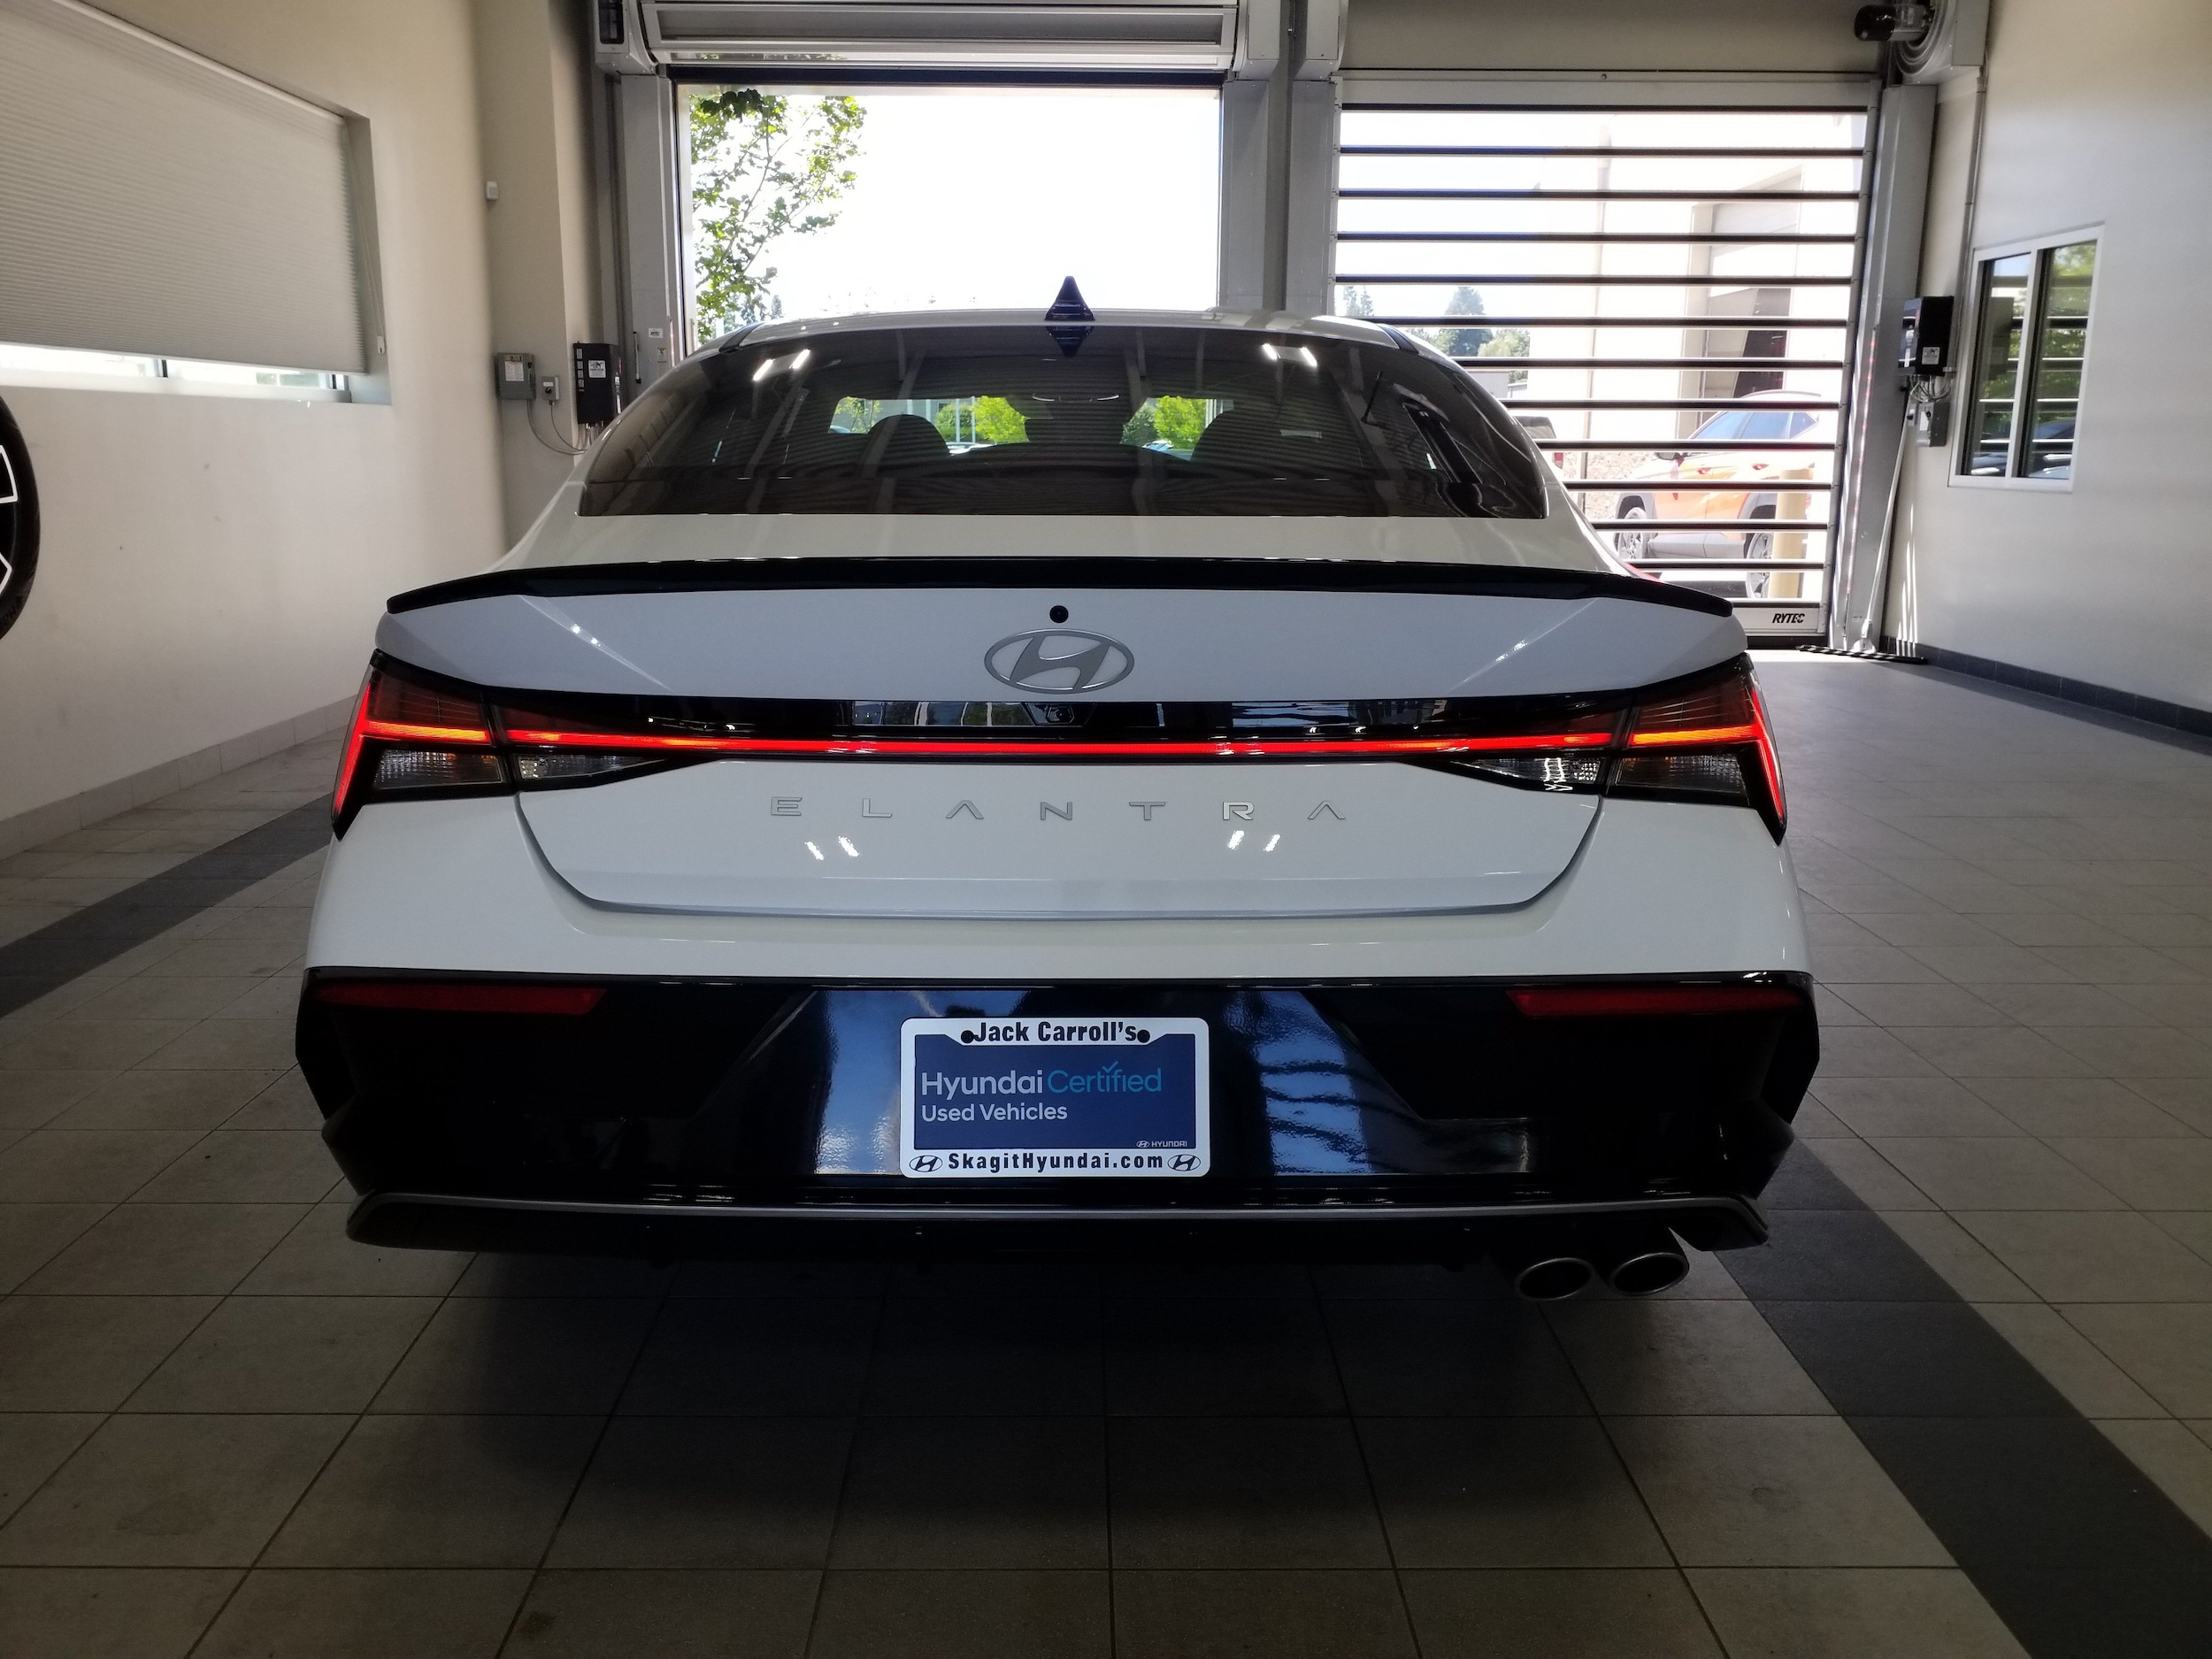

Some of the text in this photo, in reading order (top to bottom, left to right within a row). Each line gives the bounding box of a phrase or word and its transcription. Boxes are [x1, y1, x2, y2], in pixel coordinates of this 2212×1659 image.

[1772, 613, 1805, 623] RYTEC
[771, 796, 1346, 820] ELANTRA
[974, 1021, 1137, 1042] Jack Carroll's
[921, 1061, 1162, 1100] Hyundai Certified
[921, 1102, 1068, 1122] Used Vehicles
[948, 1153, 1163, 1172] SkagitHyundai.com
